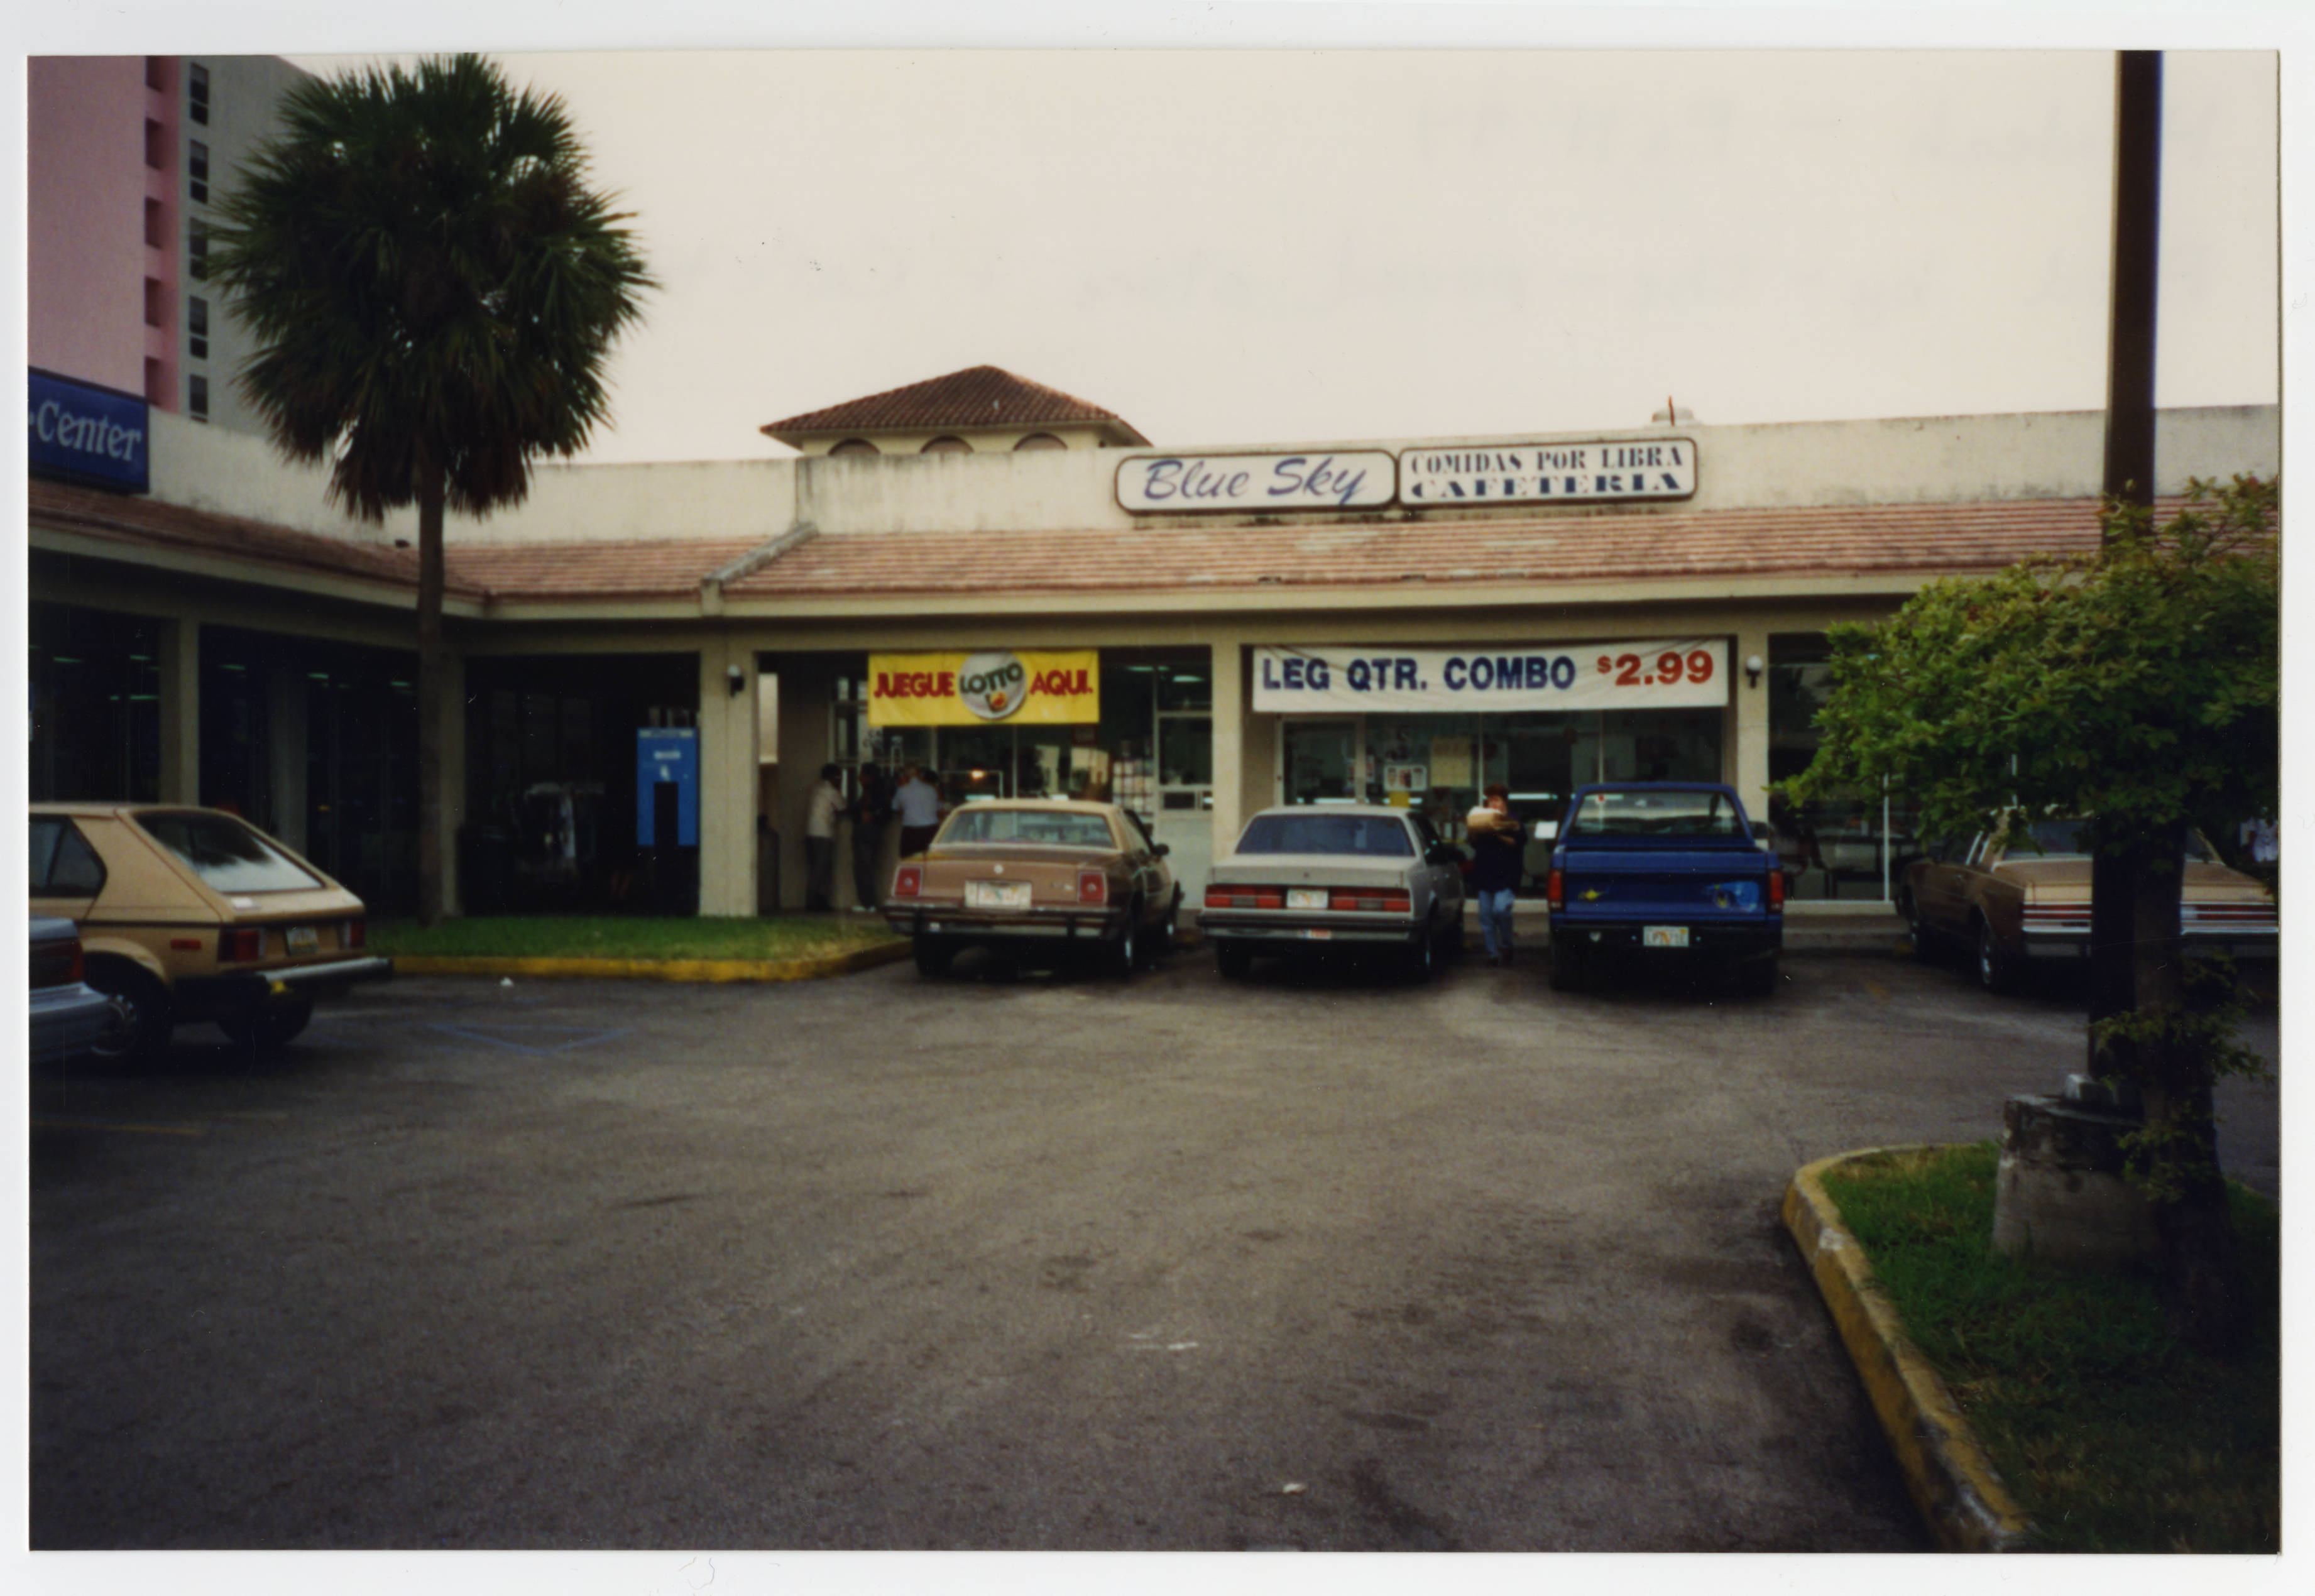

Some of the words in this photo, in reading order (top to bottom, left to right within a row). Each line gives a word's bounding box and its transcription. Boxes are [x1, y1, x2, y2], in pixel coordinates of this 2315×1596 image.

[1411, 451, 1522, 475] COMIDAS
[1537, 449, 1585, 471] POR
[1601, 445, 1682, 468] LIBRA
[1143, 459, 1250, 500] Blue
[1267, 456, 1366, 506] Sky
[1411, 473, 1680, 498] CAFETERIA
[874, 672, 956, 698] JUEGUE
[960, 662, 1024, 694] LOTTO
[1030, 670, 1093, 696] AQUI.
[1262, 657, 1330, 691] LEG
[1347, 657, 1428, 691] QTR.
[1443, 655, 1576, 691] COMBO
[1597, 650, 1714, 687] $2.99
